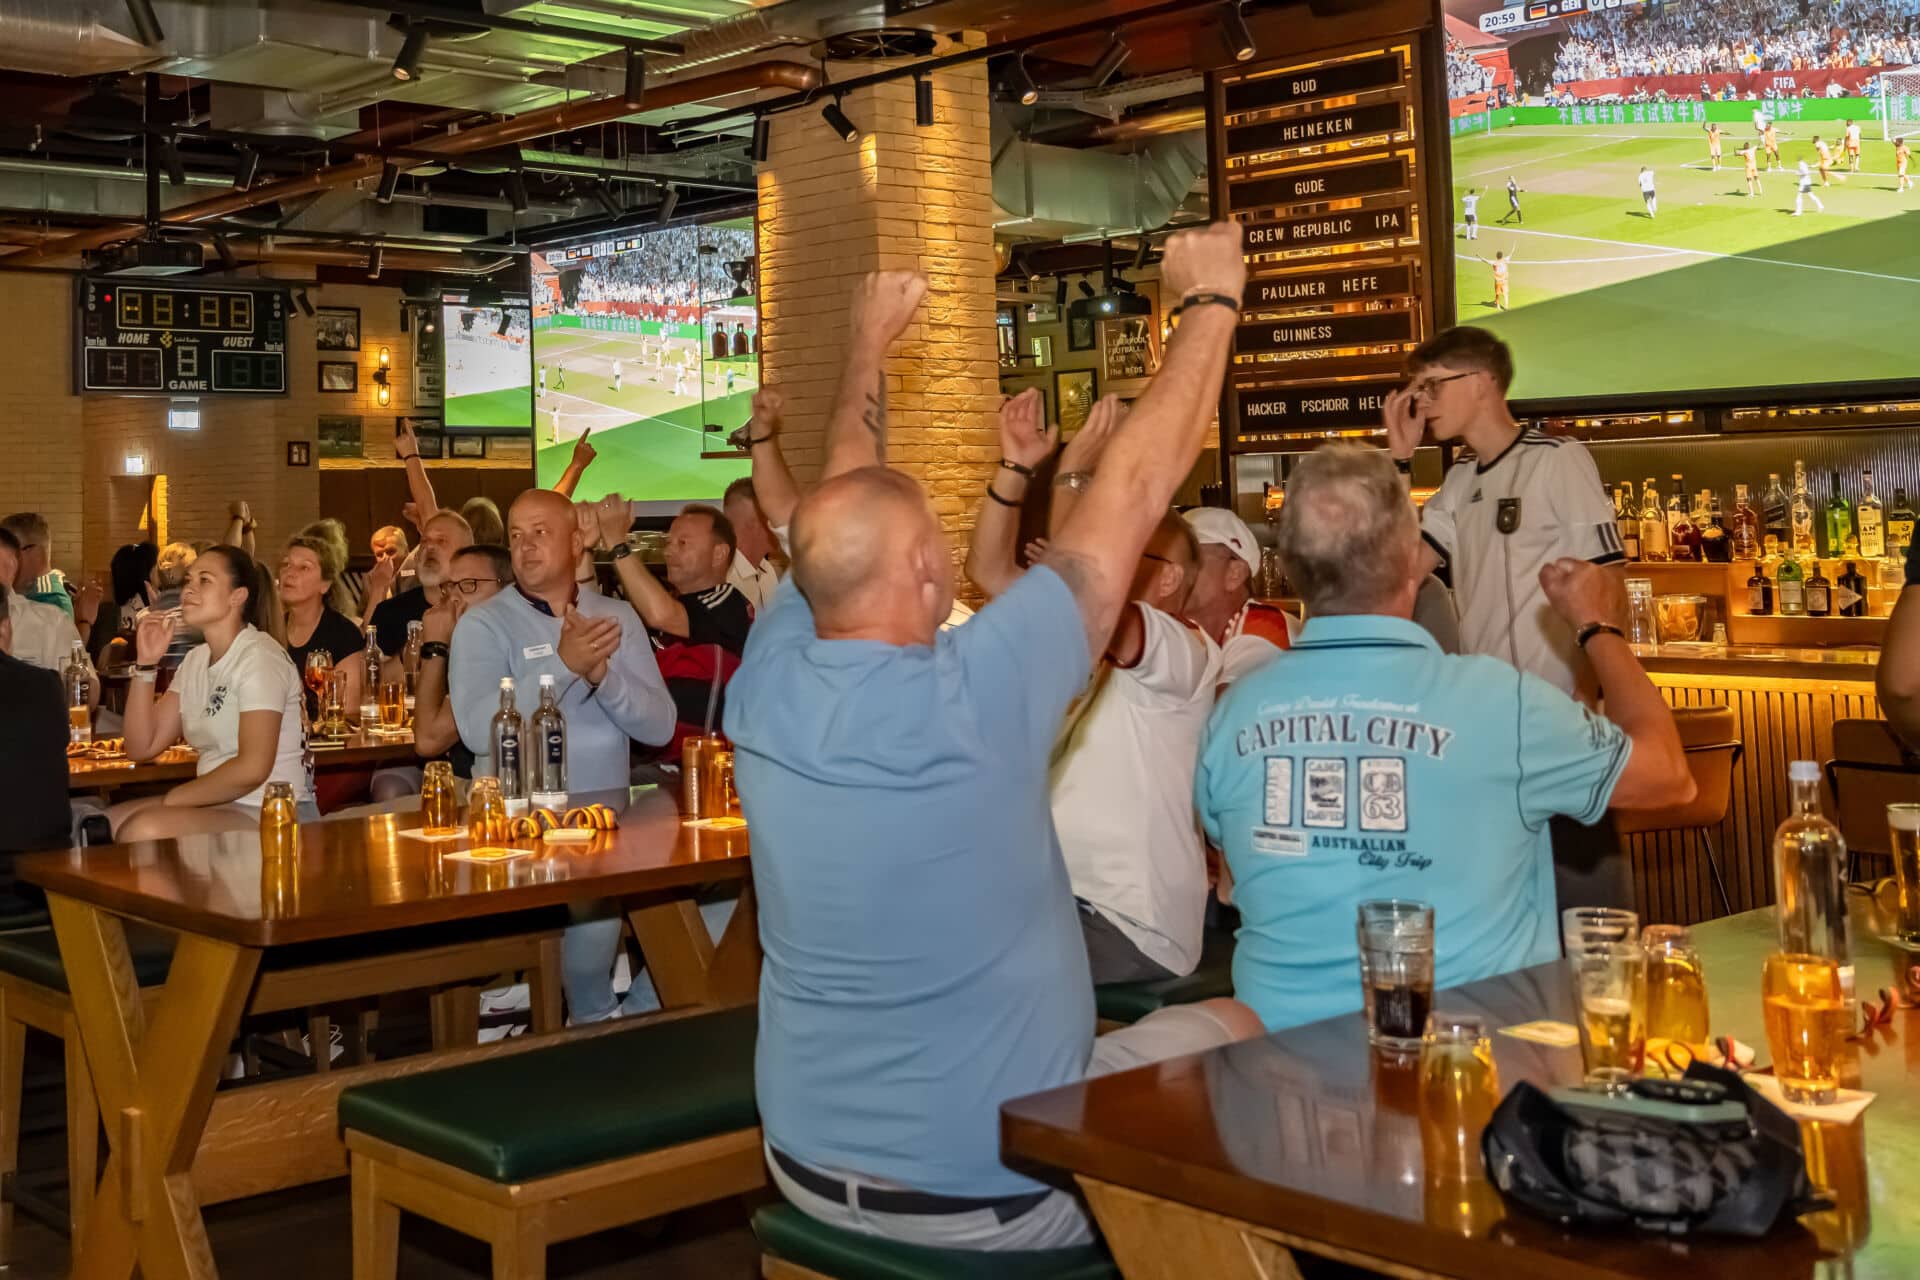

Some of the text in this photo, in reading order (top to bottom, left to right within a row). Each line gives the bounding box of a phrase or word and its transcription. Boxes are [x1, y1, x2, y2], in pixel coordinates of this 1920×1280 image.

[1485, 12, 1516, 27] 20:59
[1292, 79, 1317, 95] BUD
[1773, 77, 1796, 89] FIFA
[1283, 118, 1353, 141] HEINEKEN
[1294, 178, 1325, 195] GUDE
[1249, 213, 1399, 244] CREW REPUBLIC IPA
[1262, 276, 1378, 300] PAULANER HEFE
[1136, 320, 1145, 338] 7
[1273, 325, 1332, 342] GUINNESS
[118, 333, 150, 345] HOME
[223, 337, 254, 348] GUEST
[168, 380, 208, 391] GAME
[1247, 401, 1287, 416] HACKER
[1301, 397, 1349, 413] PSCHORR
[1234, 712, 1454, 760] CAPITAL CITY
[1363, 793, 1402, 820] 63
[1311, 836, 1406, 852] AUSTRALIAN
[1358, 851, 1433, 871] City Trip
